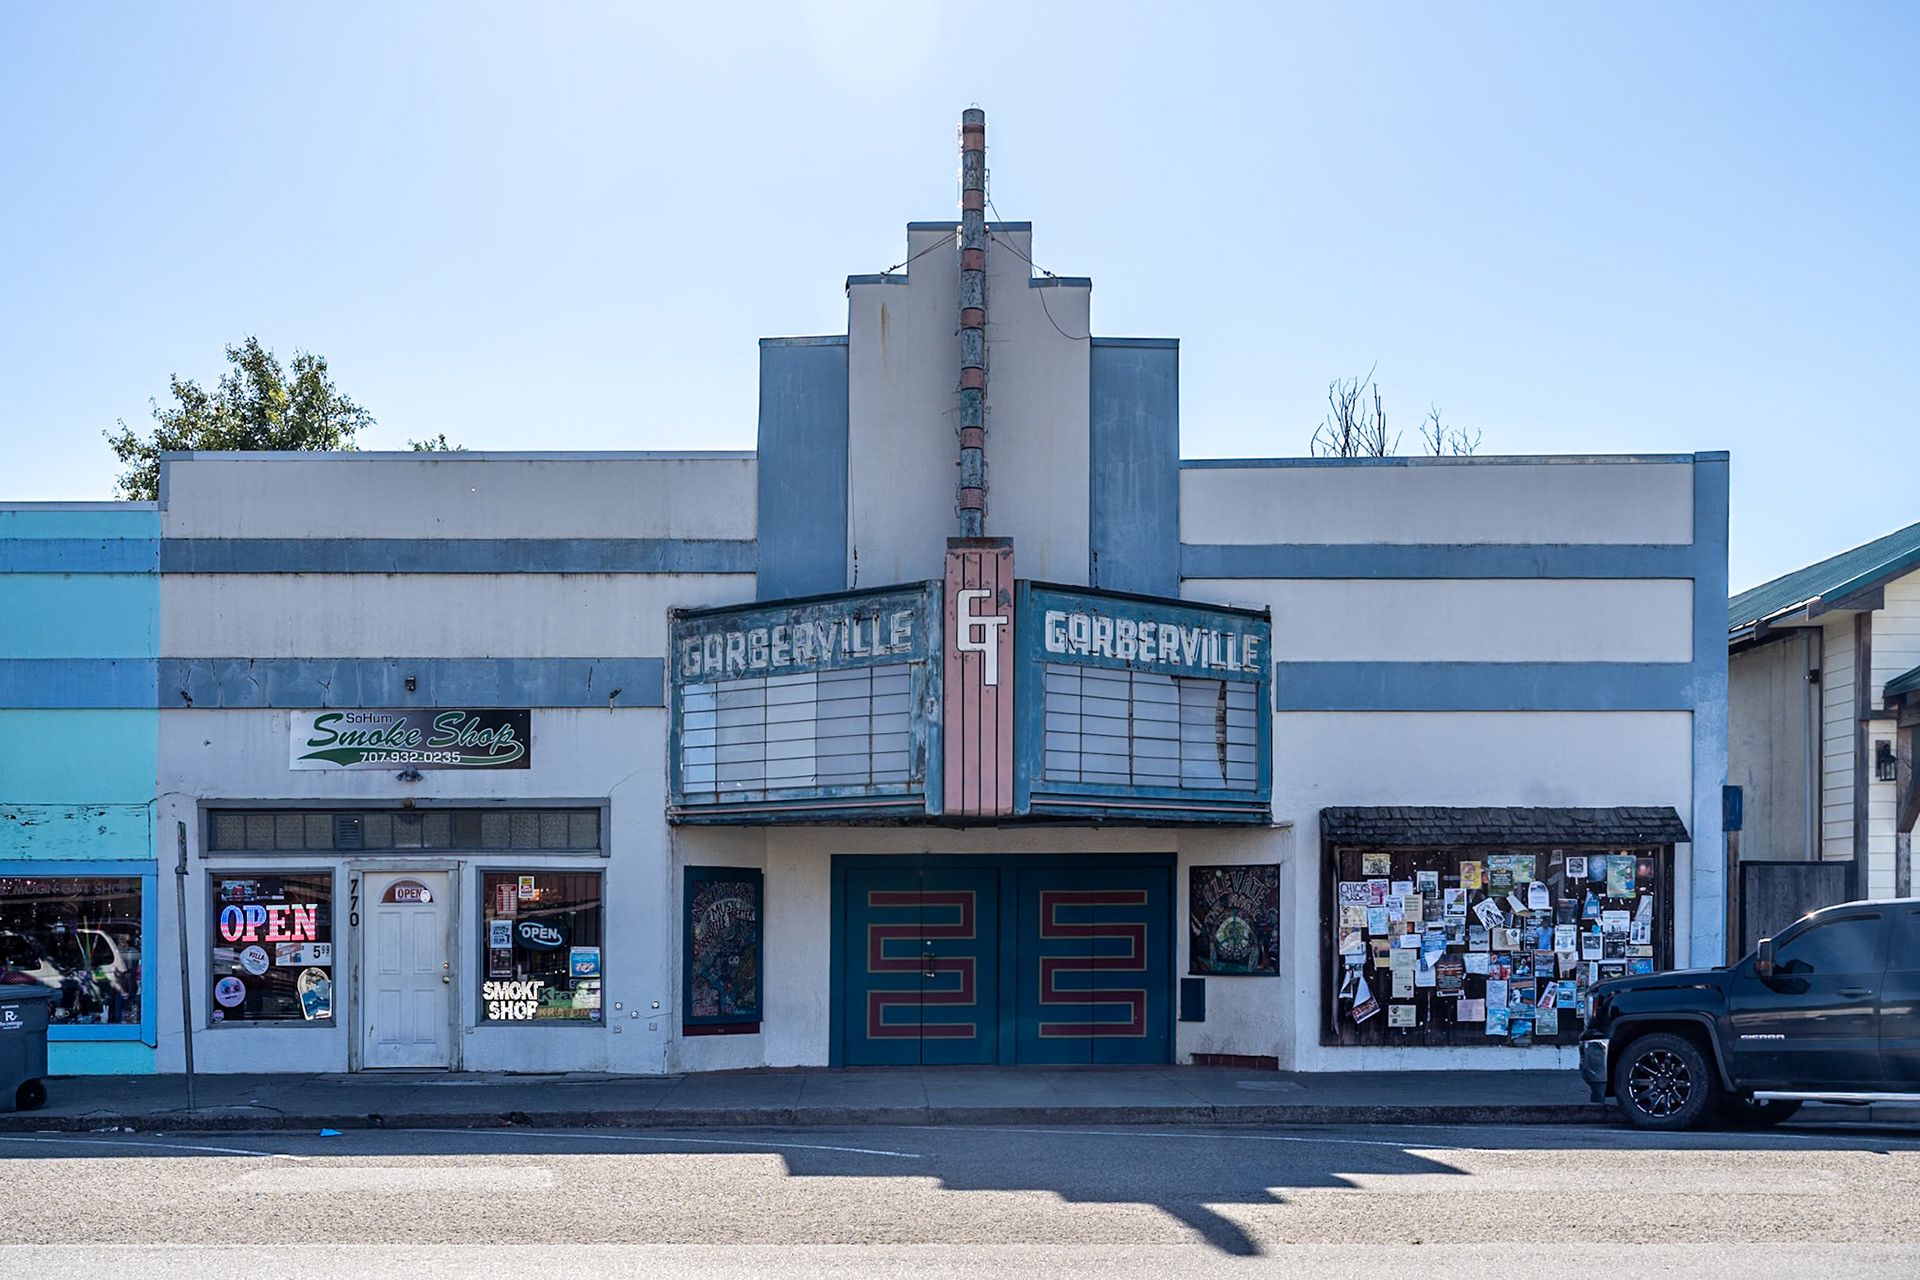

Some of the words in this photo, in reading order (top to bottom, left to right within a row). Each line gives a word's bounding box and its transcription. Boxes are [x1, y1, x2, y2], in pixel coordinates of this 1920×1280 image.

[682, 609, 914, 677] GARBERVILLE
[1044, 609, 1263, 673] GARBERVILLE
[346, 712, 392, 724] SoHum
[306, 712, 422, 747] Smoke
[426, 711, 516, 755] Shop
[359, 751, 461, 763] 707-932-0235
[13, 883, 56, 896] MOON
[61, 883, 89, 895] GIFT
[93, 883, 132, 895] SHOP
[397, 888, 421, 899] OPEN
[350, 879, 359, 927] 770
[220, 904, 318, 942] OPEN
[521, 927, 558, 939] OPEN
[488, 1001, 539, 1020] SHOP
